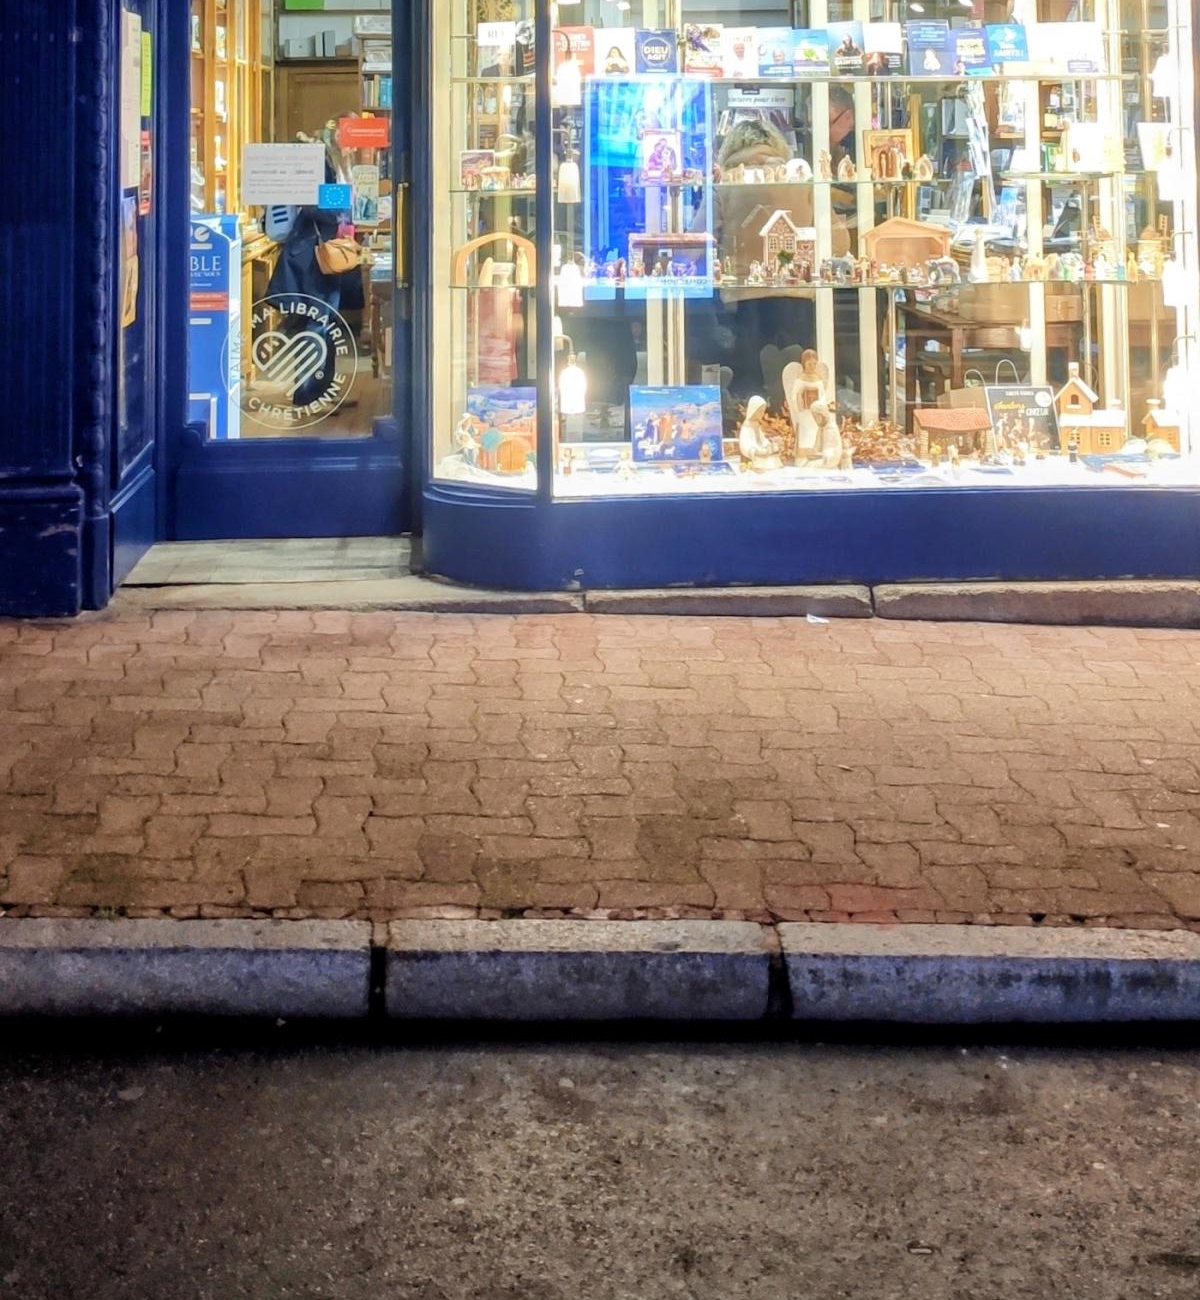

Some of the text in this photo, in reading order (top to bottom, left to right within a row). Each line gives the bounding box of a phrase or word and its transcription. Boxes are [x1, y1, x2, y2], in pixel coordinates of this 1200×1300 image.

[643, 46, 669, 54] DIEU
[189, 255, 222, 272] BLE
[251, 306, 276, 329] MA
[279, 301, 349, 356] LIBRAIRIE
